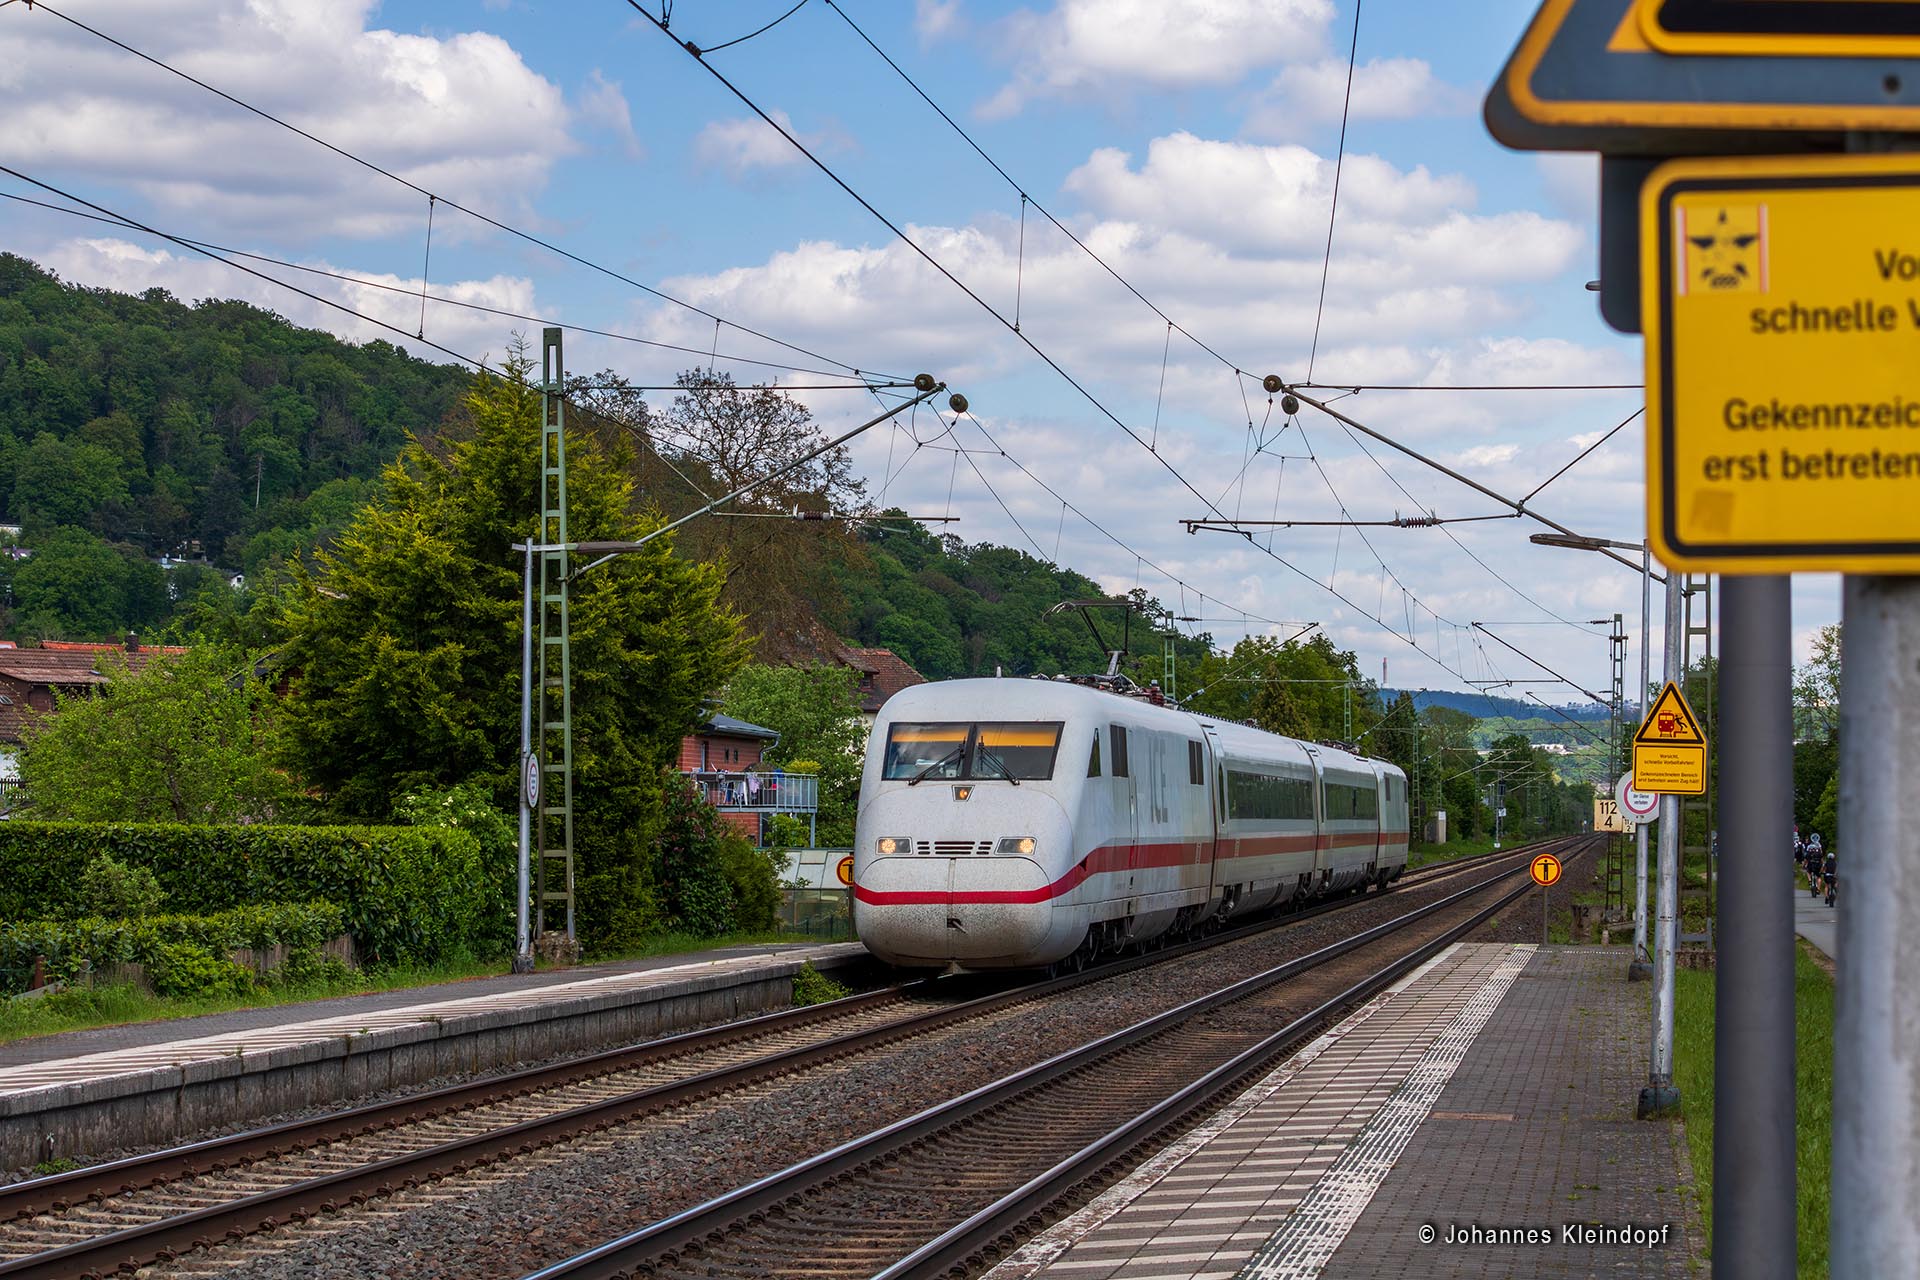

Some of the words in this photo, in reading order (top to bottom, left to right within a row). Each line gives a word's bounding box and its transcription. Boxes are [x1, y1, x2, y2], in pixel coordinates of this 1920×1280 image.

[1873, 247, 1920, 282] Vo
[1751, 297, 1898, 333] schnelle
[1723, 395, 1920, 431] Gekennzeic
[1703, 448, 1770, 481] erst
[1781, 446, 1920, 480] betreten
[1600, 801, 1618, 814] 112
[1604, 816, 1612, 828] 4
